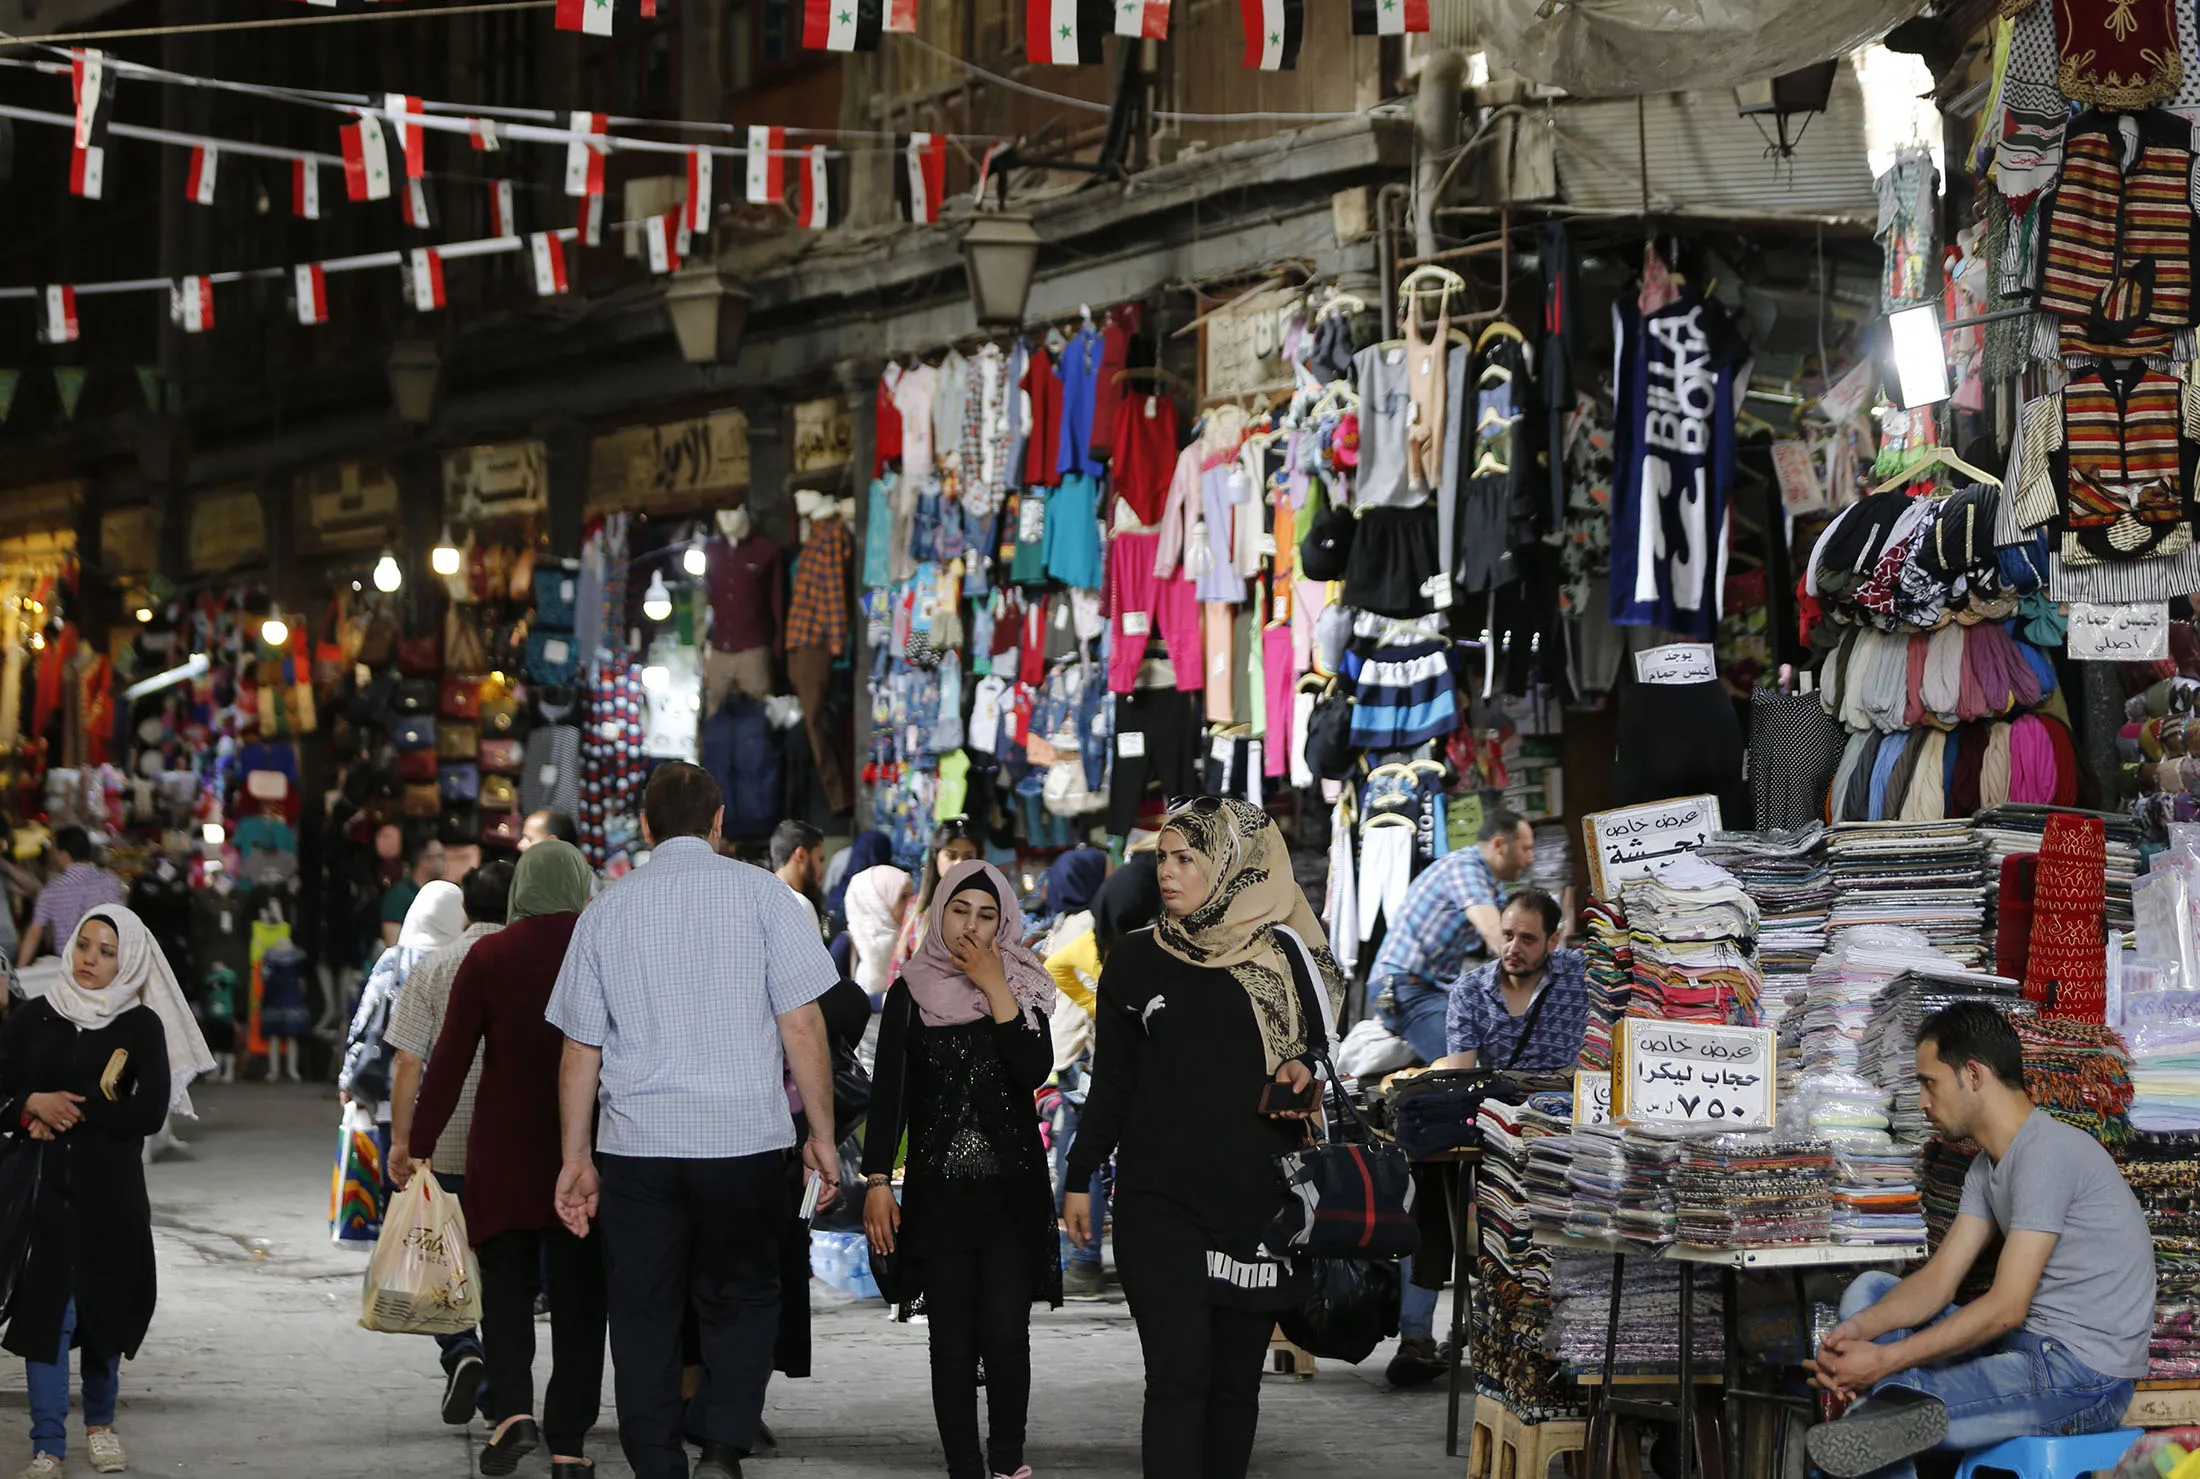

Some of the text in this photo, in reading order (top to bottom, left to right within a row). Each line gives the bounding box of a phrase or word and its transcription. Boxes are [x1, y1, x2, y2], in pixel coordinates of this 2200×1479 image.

[1664, 651, 1694, 663] يوجد
[1683, 666, 1710, 679] كيس
[1606, 810, 1698, 837] عرض خاص
[1640, 1034, 1753, 1061] عرض خاص
[1639, 1061, 1760, 1091] حجاب ليكرا
[1677, 1093, 1746, 1119] ٧٥٠
